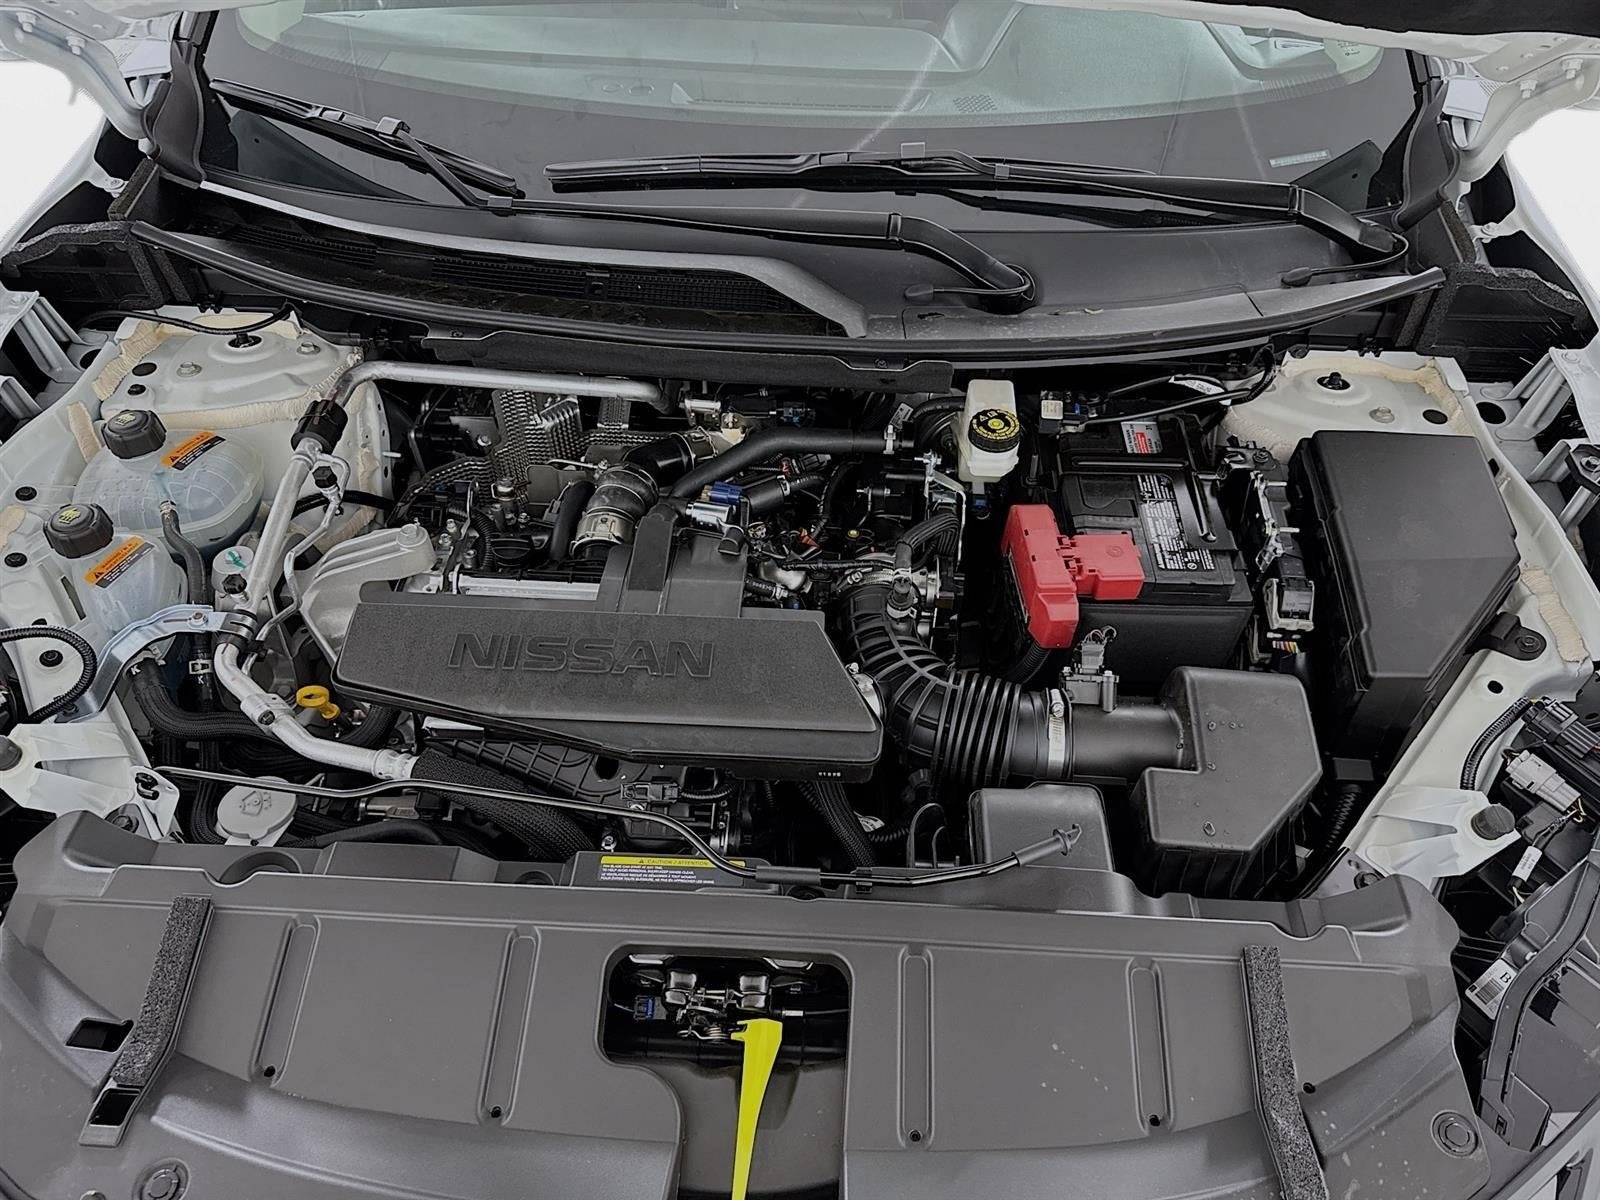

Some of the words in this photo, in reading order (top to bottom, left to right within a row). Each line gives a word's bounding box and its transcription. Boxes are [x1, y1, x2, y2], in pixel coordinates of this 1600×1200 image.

[448, 633, 714, 678] NISSAN
[131, 664, 141, 675] K
[197, 675, 204, 684] K
[1499, 971, 1512, 983] B
